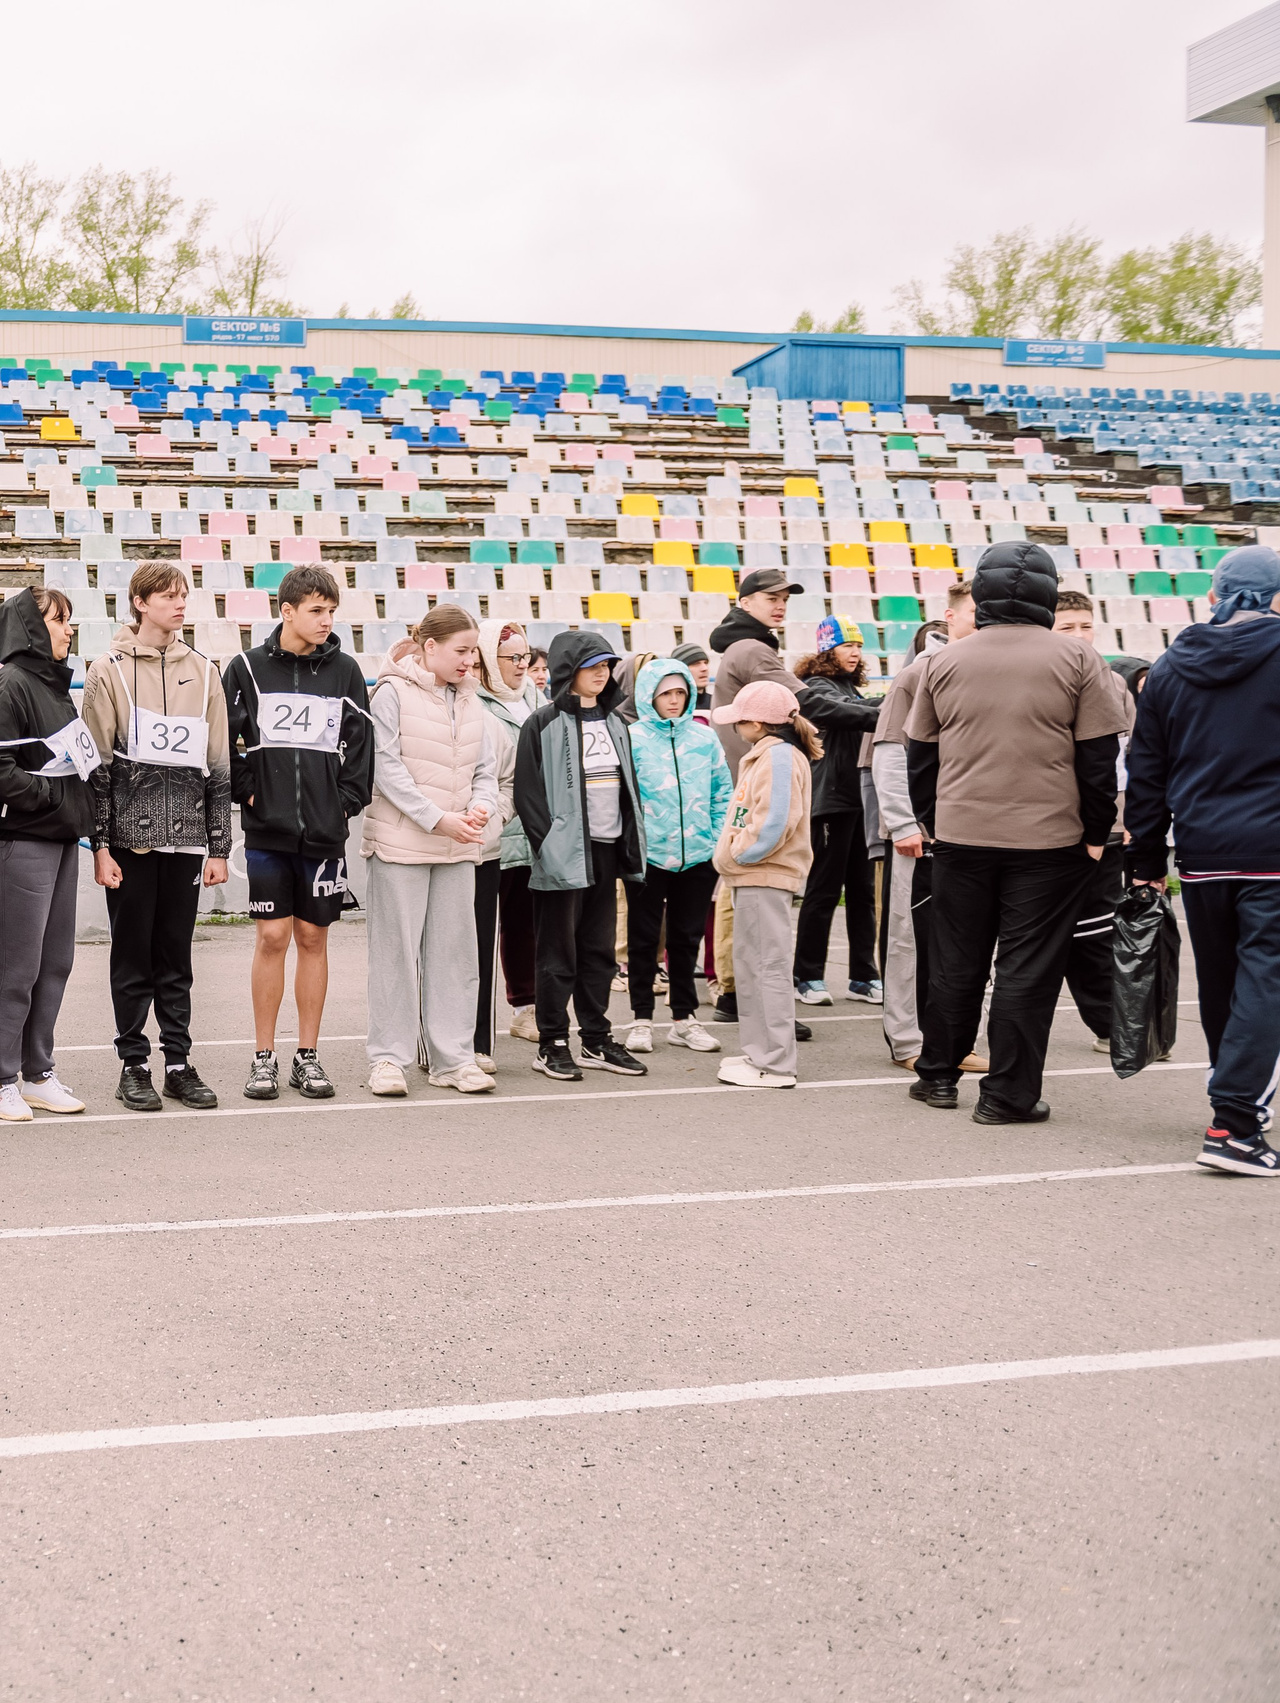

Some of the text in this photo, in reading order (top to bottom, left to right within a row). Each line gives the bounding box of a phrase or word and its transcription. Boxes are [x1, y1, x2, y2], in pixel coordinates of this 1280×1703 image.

[211, 321, 257, 332] СЕКТОР
[109, 652, 124, 665] NKE
[272, 705, 312, 732] 24
[150, 722, 190, 754] 32
[582, 731, 611, 758] 28
[732, 806, 749, 829] K
